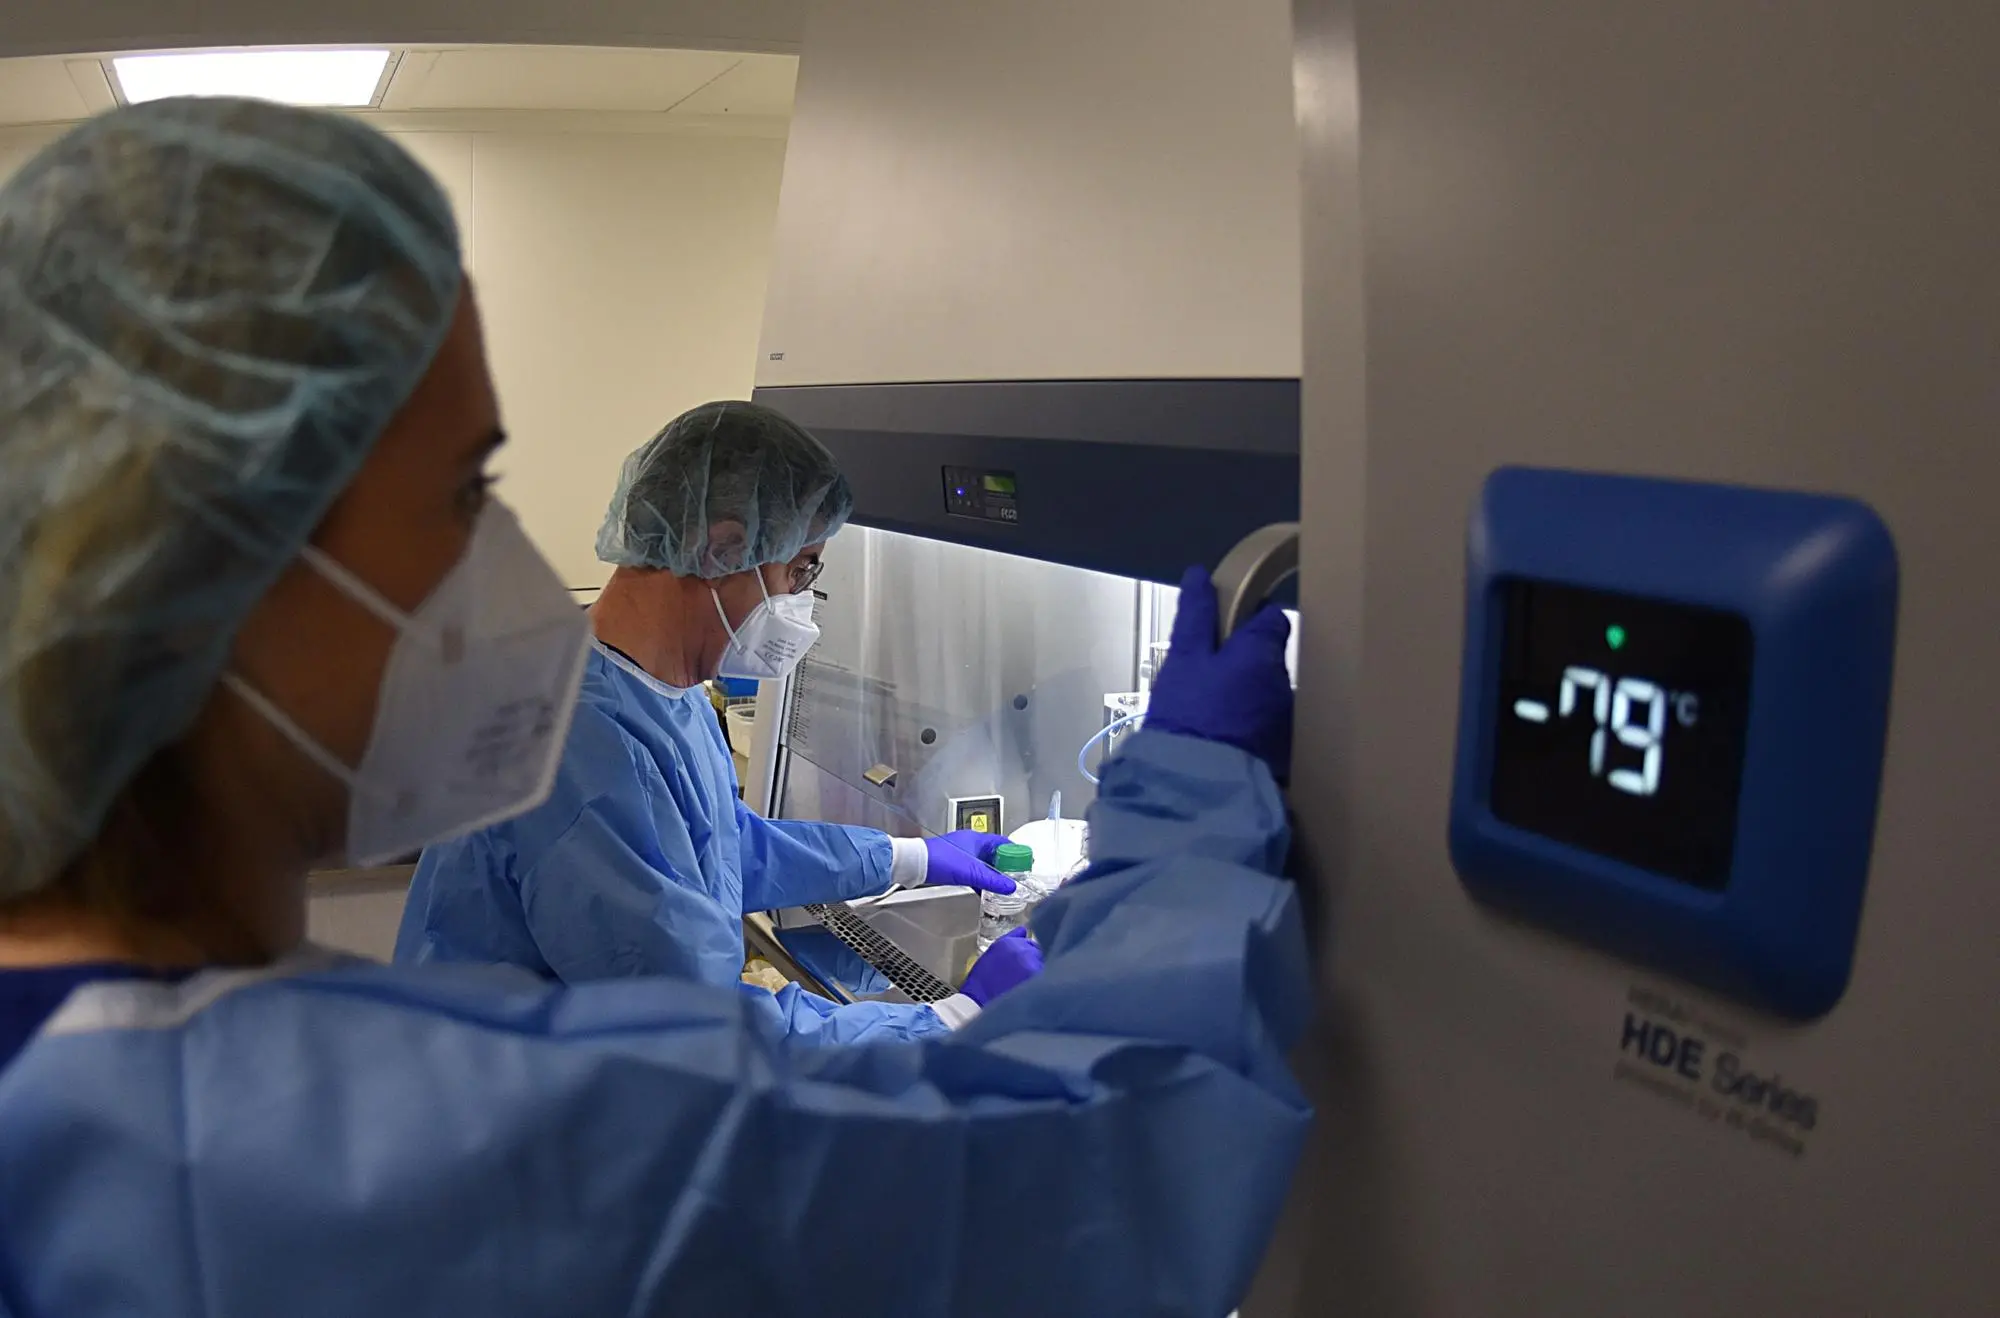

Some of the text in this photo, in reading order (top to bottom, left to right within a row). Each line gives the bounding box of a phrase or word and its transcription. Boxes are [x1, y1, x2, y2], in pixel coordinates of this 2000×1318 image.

[1513, 666, 1664, 795] -79
[1620, 1012, 1705, 1080] HDE
[1711, 1052, 1818, 1131] Series
